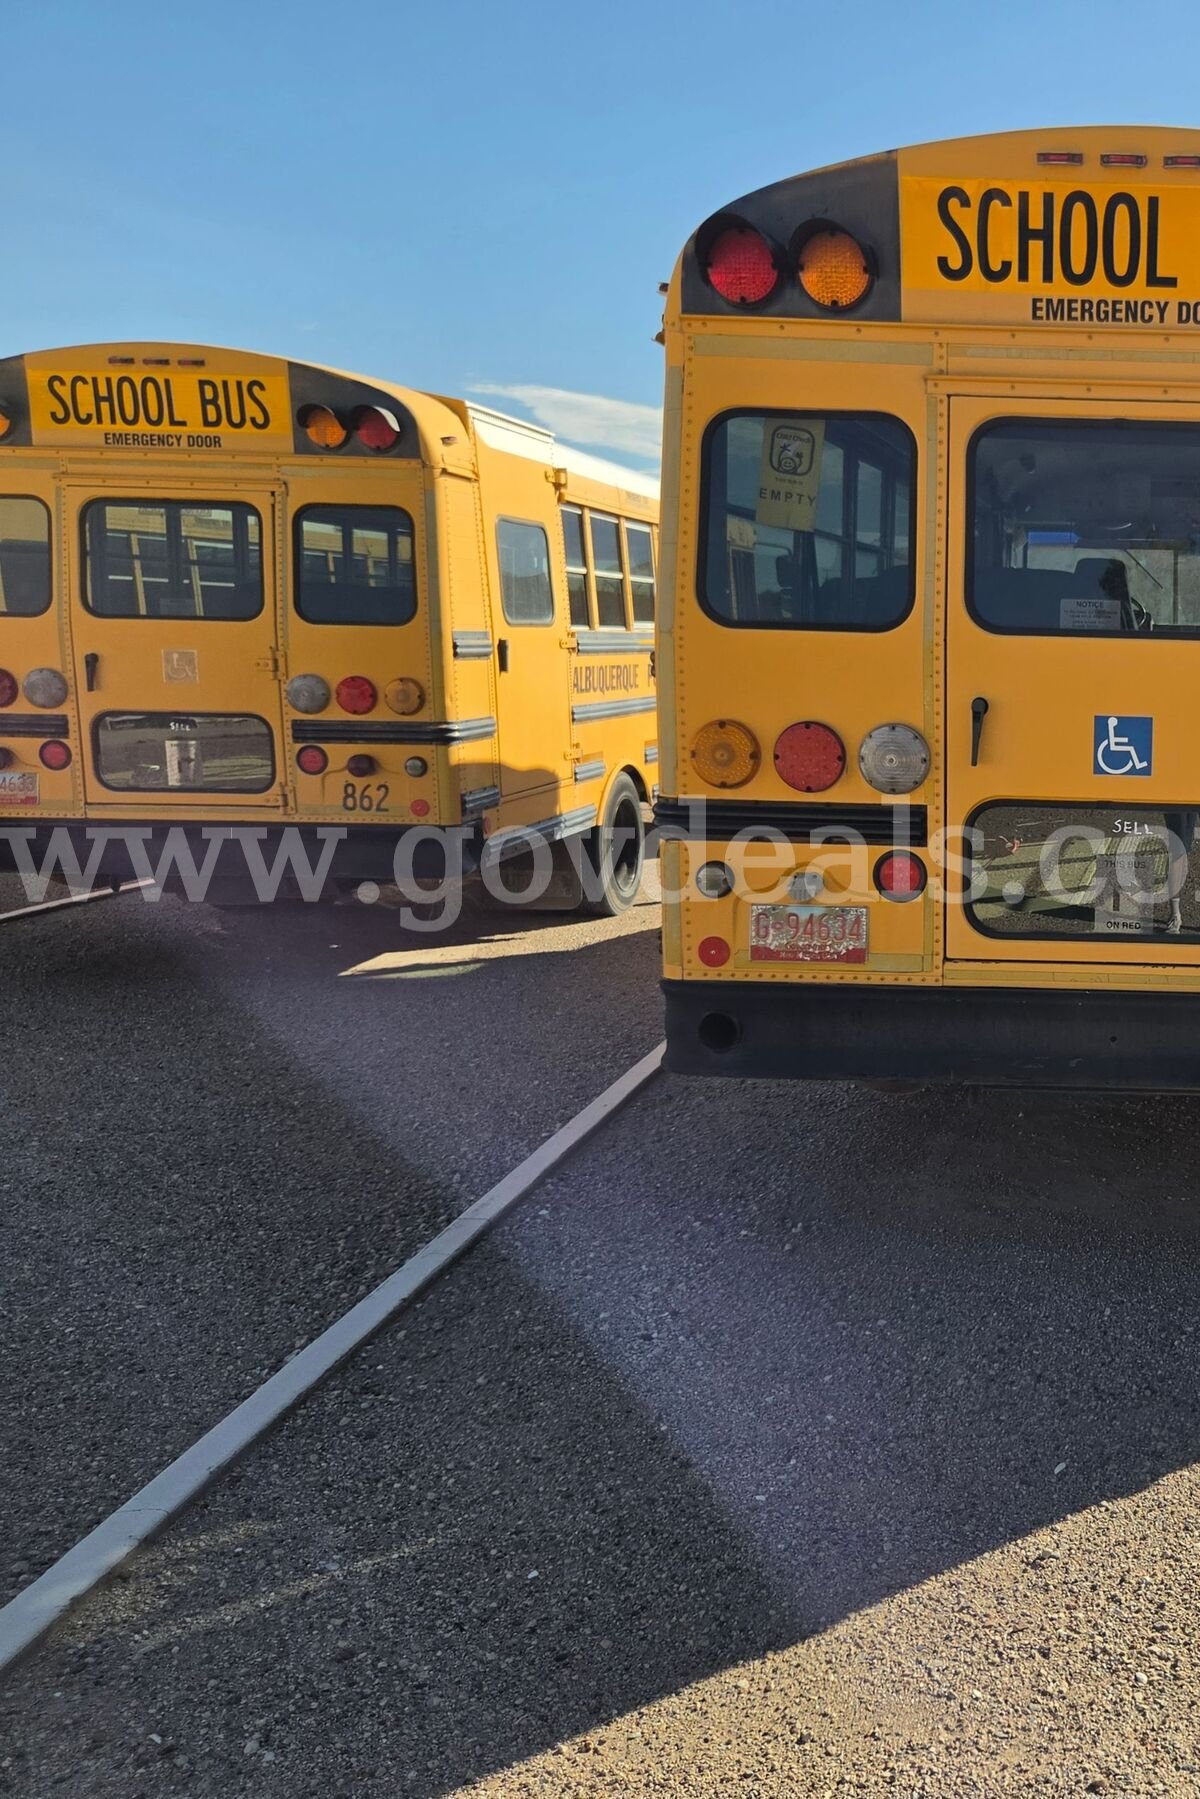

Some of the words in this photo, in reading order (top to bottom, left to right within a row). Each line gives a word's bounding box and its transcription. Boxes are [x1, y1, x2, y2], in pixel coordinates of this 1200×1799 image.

[937, 186, 1177, 288] SCHOOL
[1031, 298, 1169, 325] EMERGENCY
[47, 375, 187, 427] SCHOOL
[198, 379, 271, 430] BUS
[104, 432, 182, 447] EMERGENCY
[187, 435, 222, 448] DOOR
[759, 488, 816, 506] EMPTY
[1076, 601, 1104, 609] NOTICE
[573, 664, 639, 695] ALBUQUERQUE
[342, 783, 390, 812] 862
[1112, 819, 1154, 835] SELL
[1104, 860, 1125, 868] THIS
[1127, 861, 1146, 869] BUS
[1106, 921, 1119, 929] ON
[1122, 921, 1141, 930] RED
